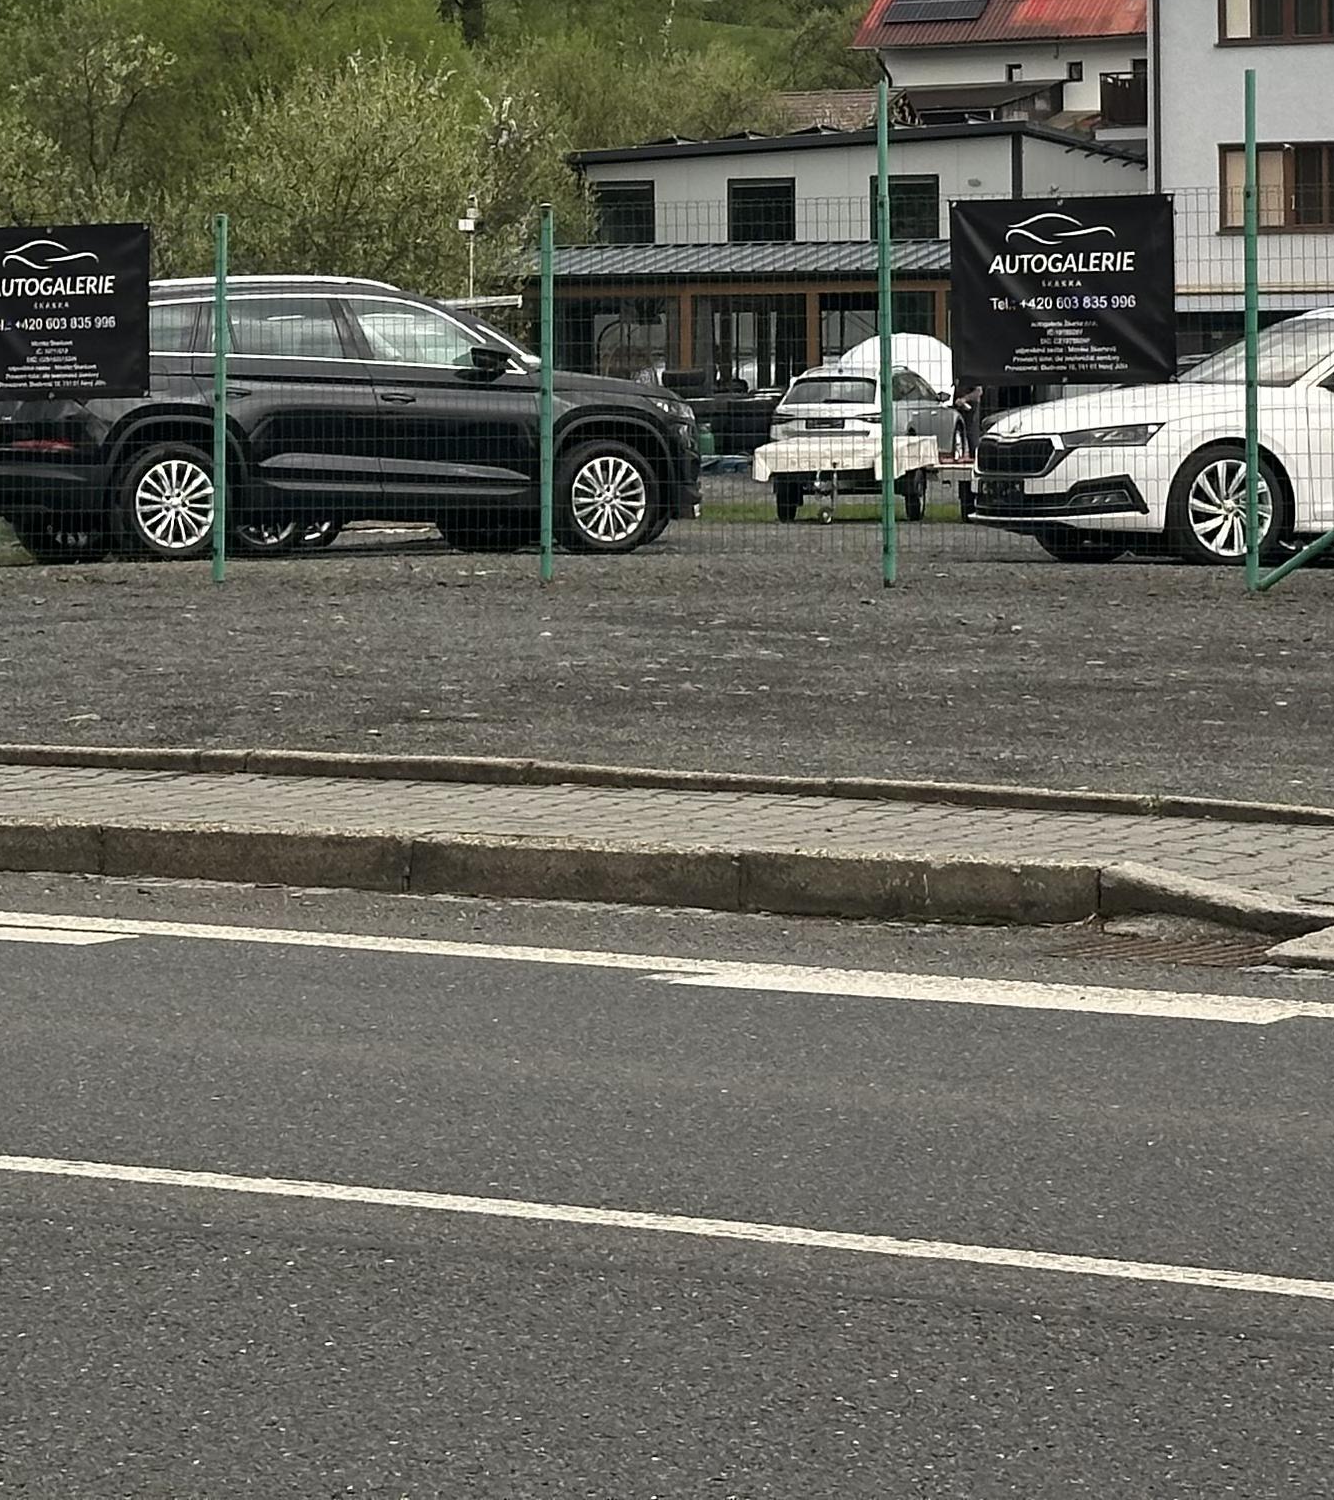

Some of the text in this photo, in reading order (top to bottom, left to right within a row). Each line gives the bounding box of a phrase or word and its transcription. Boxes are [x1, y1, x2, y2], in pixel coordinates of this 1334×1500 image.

[988, 251, 1136, 274] AUTOGALERIE
[1019, 297, 1053, 310] +420
[1056, 296, 1079, 310] 603
[1082, 295, 1108, 309] 835
[1111, 295, 1136, 309] 996
[15, 318, 43, 331] +420
[45, 317, 67, 330] 603
[70, 316, 92, 330] 835
[94, 316, 116, 329] 996
